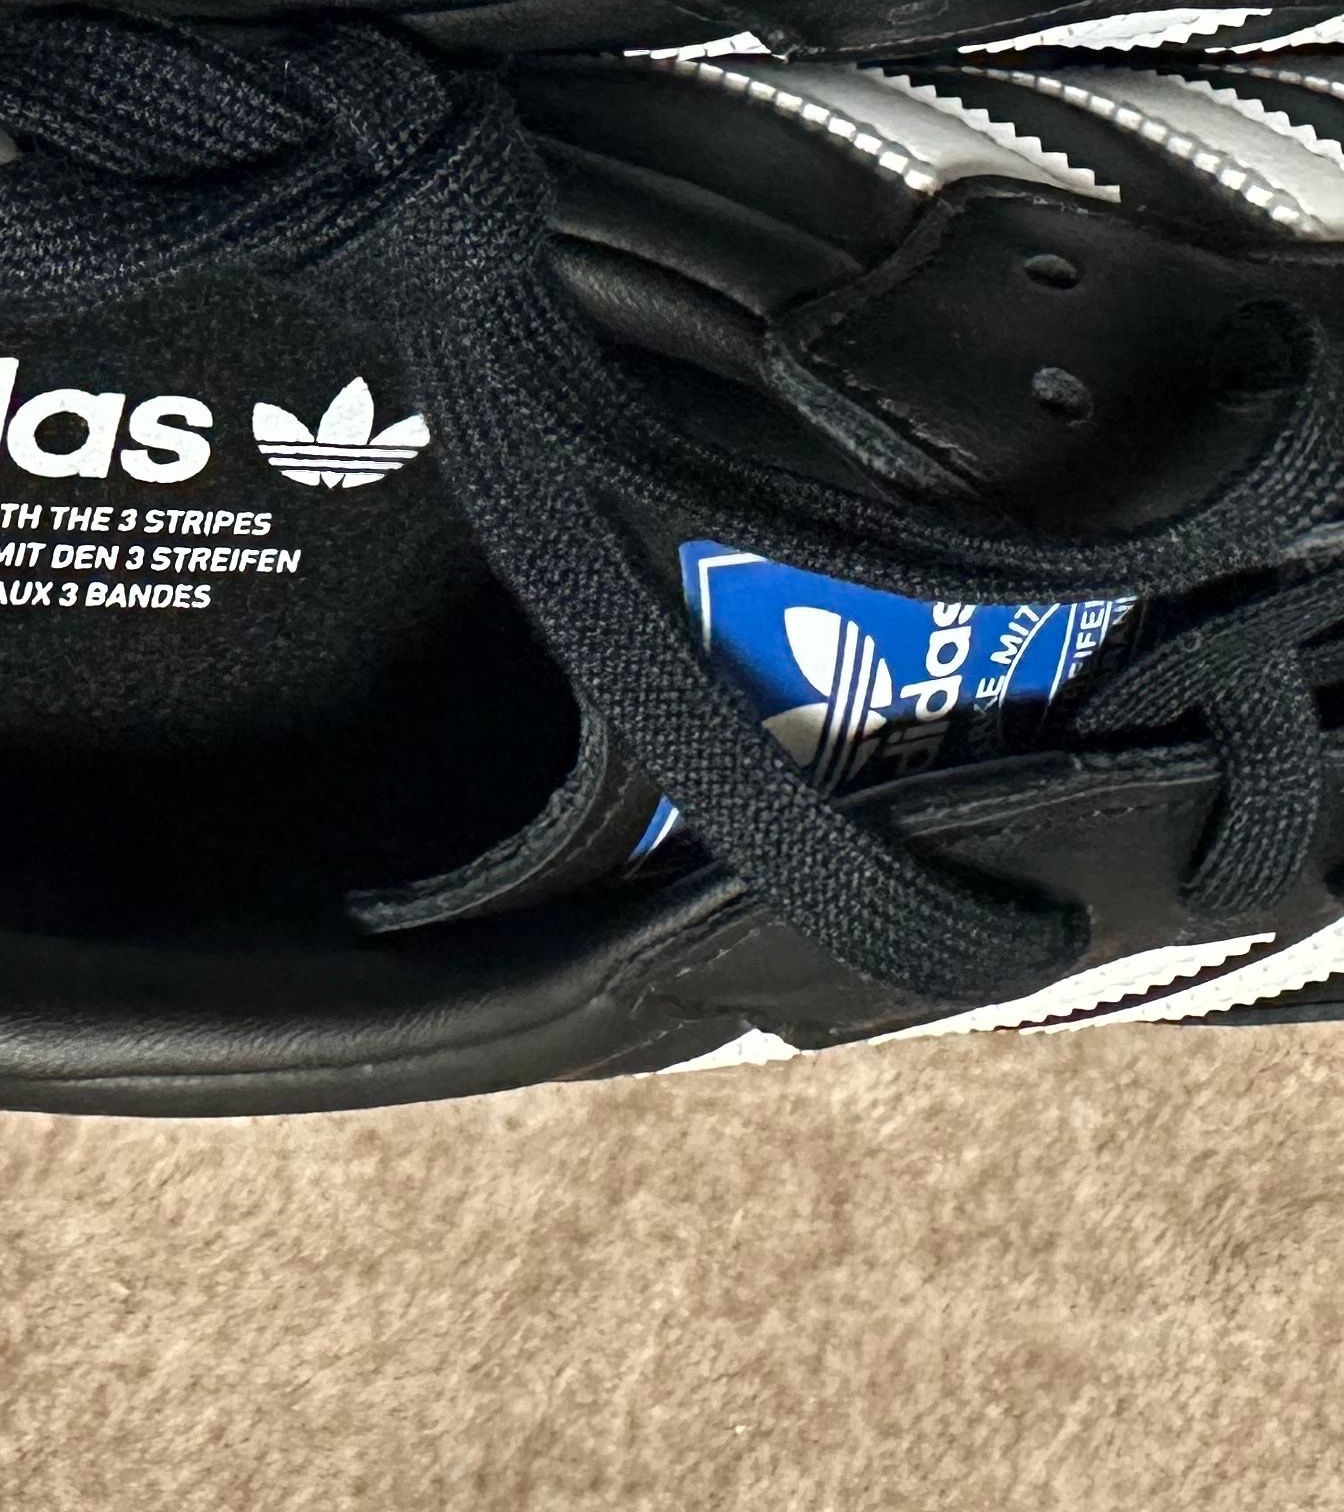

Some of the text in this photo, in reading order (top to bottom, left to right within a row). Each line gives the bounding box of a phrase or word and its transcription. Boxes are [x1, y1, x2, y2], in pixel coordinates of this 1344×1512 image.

[51, 507, 114, 531] THE
[118, 509, 137, 531] 3
[144, 510, 272, 536] STRIPES
[51, 544, 119, 570] DEN
[125, 546, 144, 570] 3
[151, 547, 301, 573] STREIFEN
[59, 583, 78, 606] 3
[85, 582, 211, 608] BANDES
